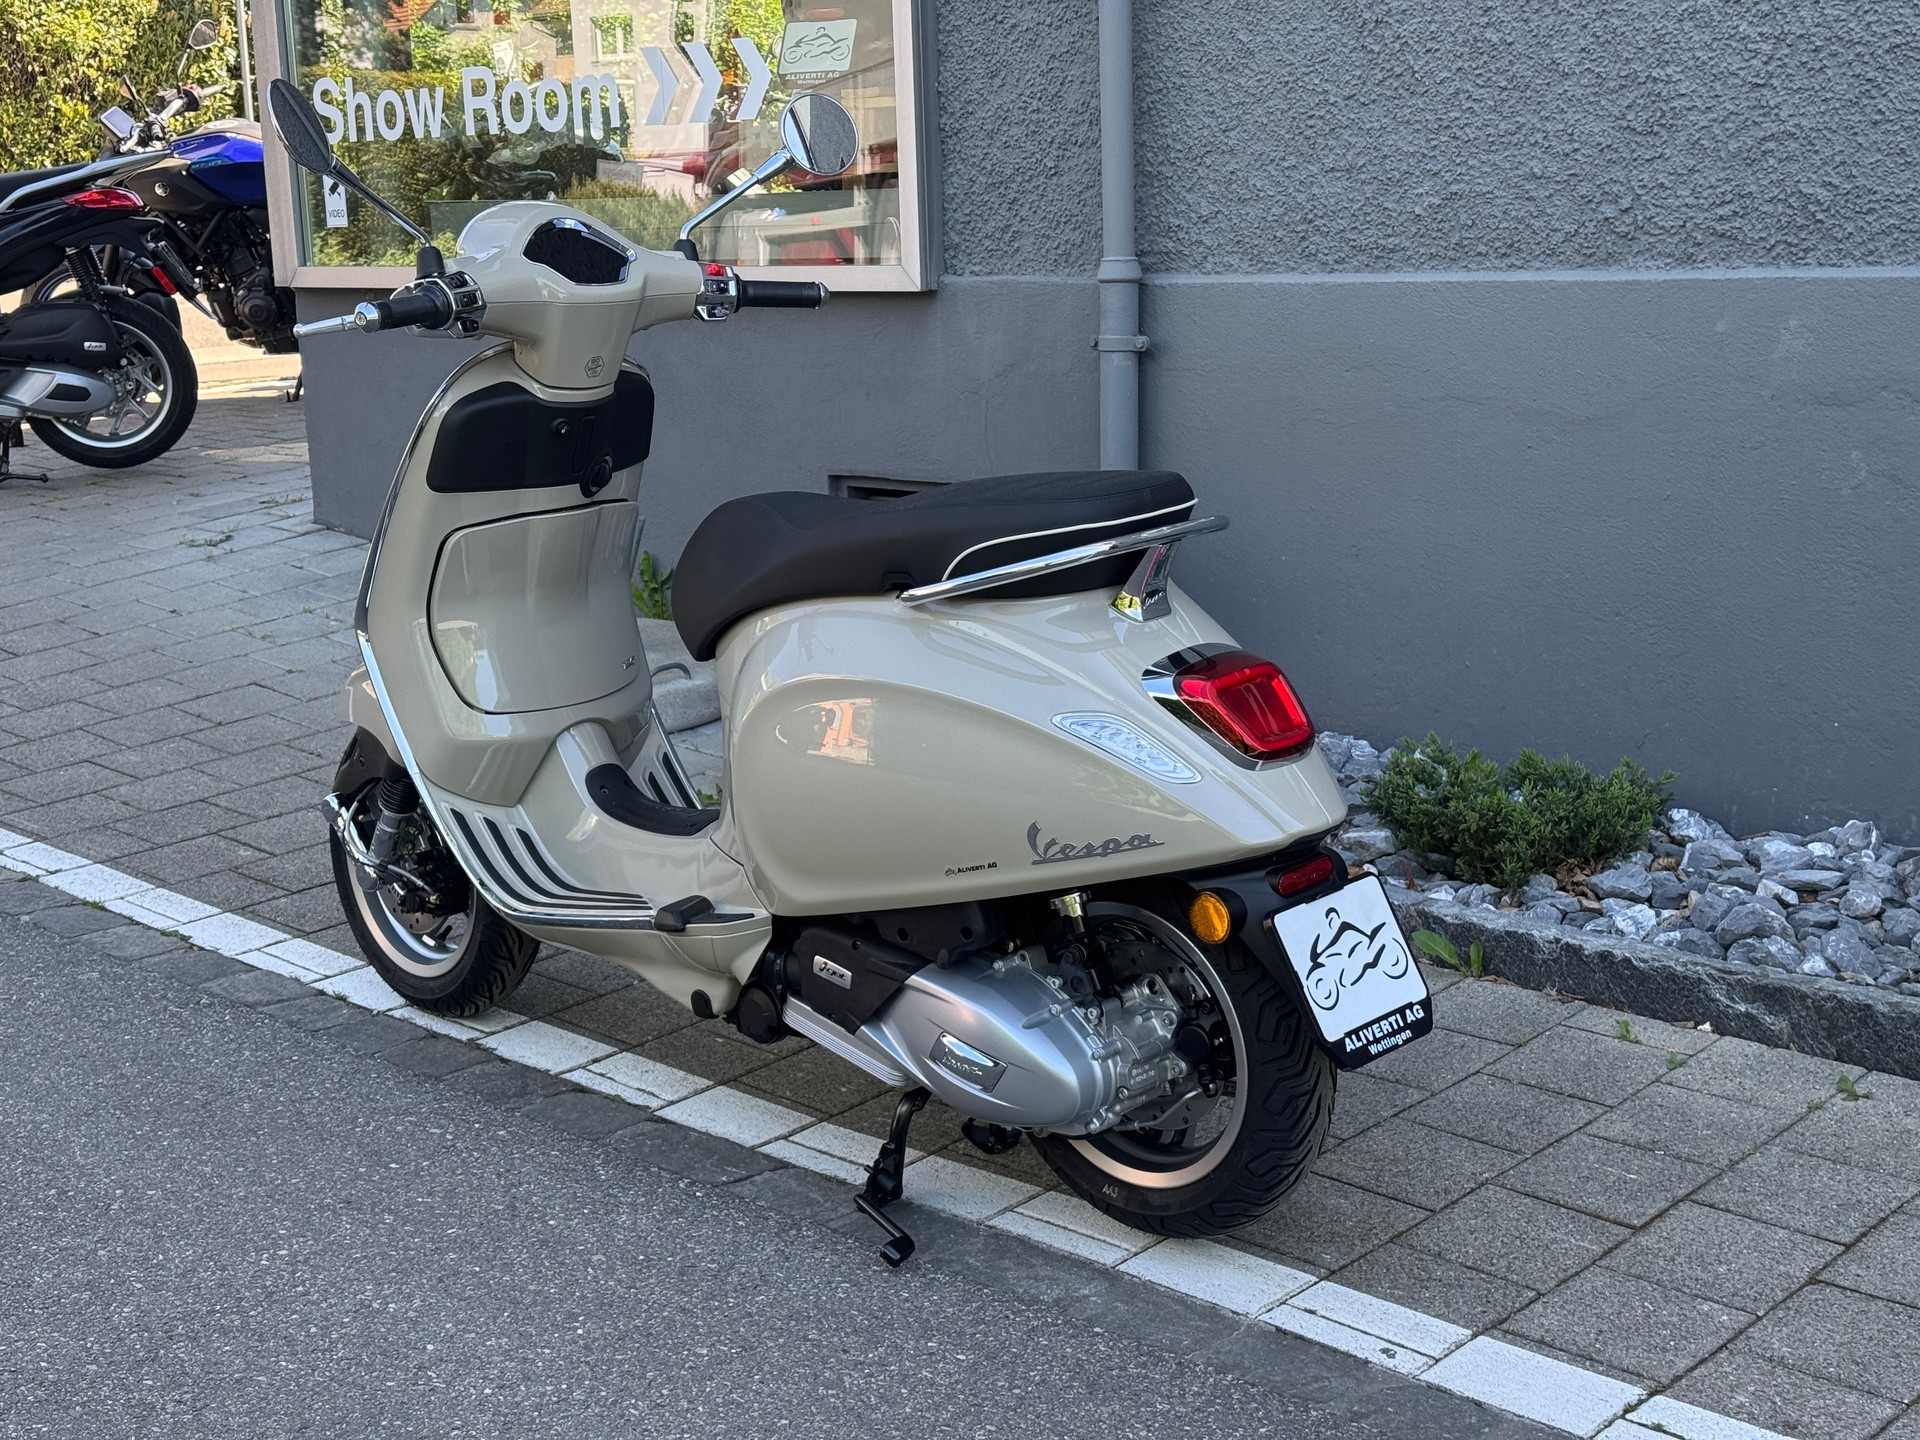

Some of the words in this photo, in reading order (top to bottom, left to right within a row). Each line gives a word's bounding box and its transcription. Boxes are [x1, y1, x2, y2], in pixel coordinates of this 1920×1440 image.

[785, 72, 826, 80] ALIVERTI
[313, 77, 444, 145] Show
[461, 65, 621, 137] Room
[328, 208, 345, 218] VIDEO
[1026, 818, 1165, 865] Vespa
[957, 864, 986, 874] ALIVERTI
[987, 861, 998, 870] AG
[1344, 1011, 1403, 1053] ALIVERTI
[1404, 1004, 1425, 1025] AG
[1368, 1029, 1413, 1056] Wettingen
